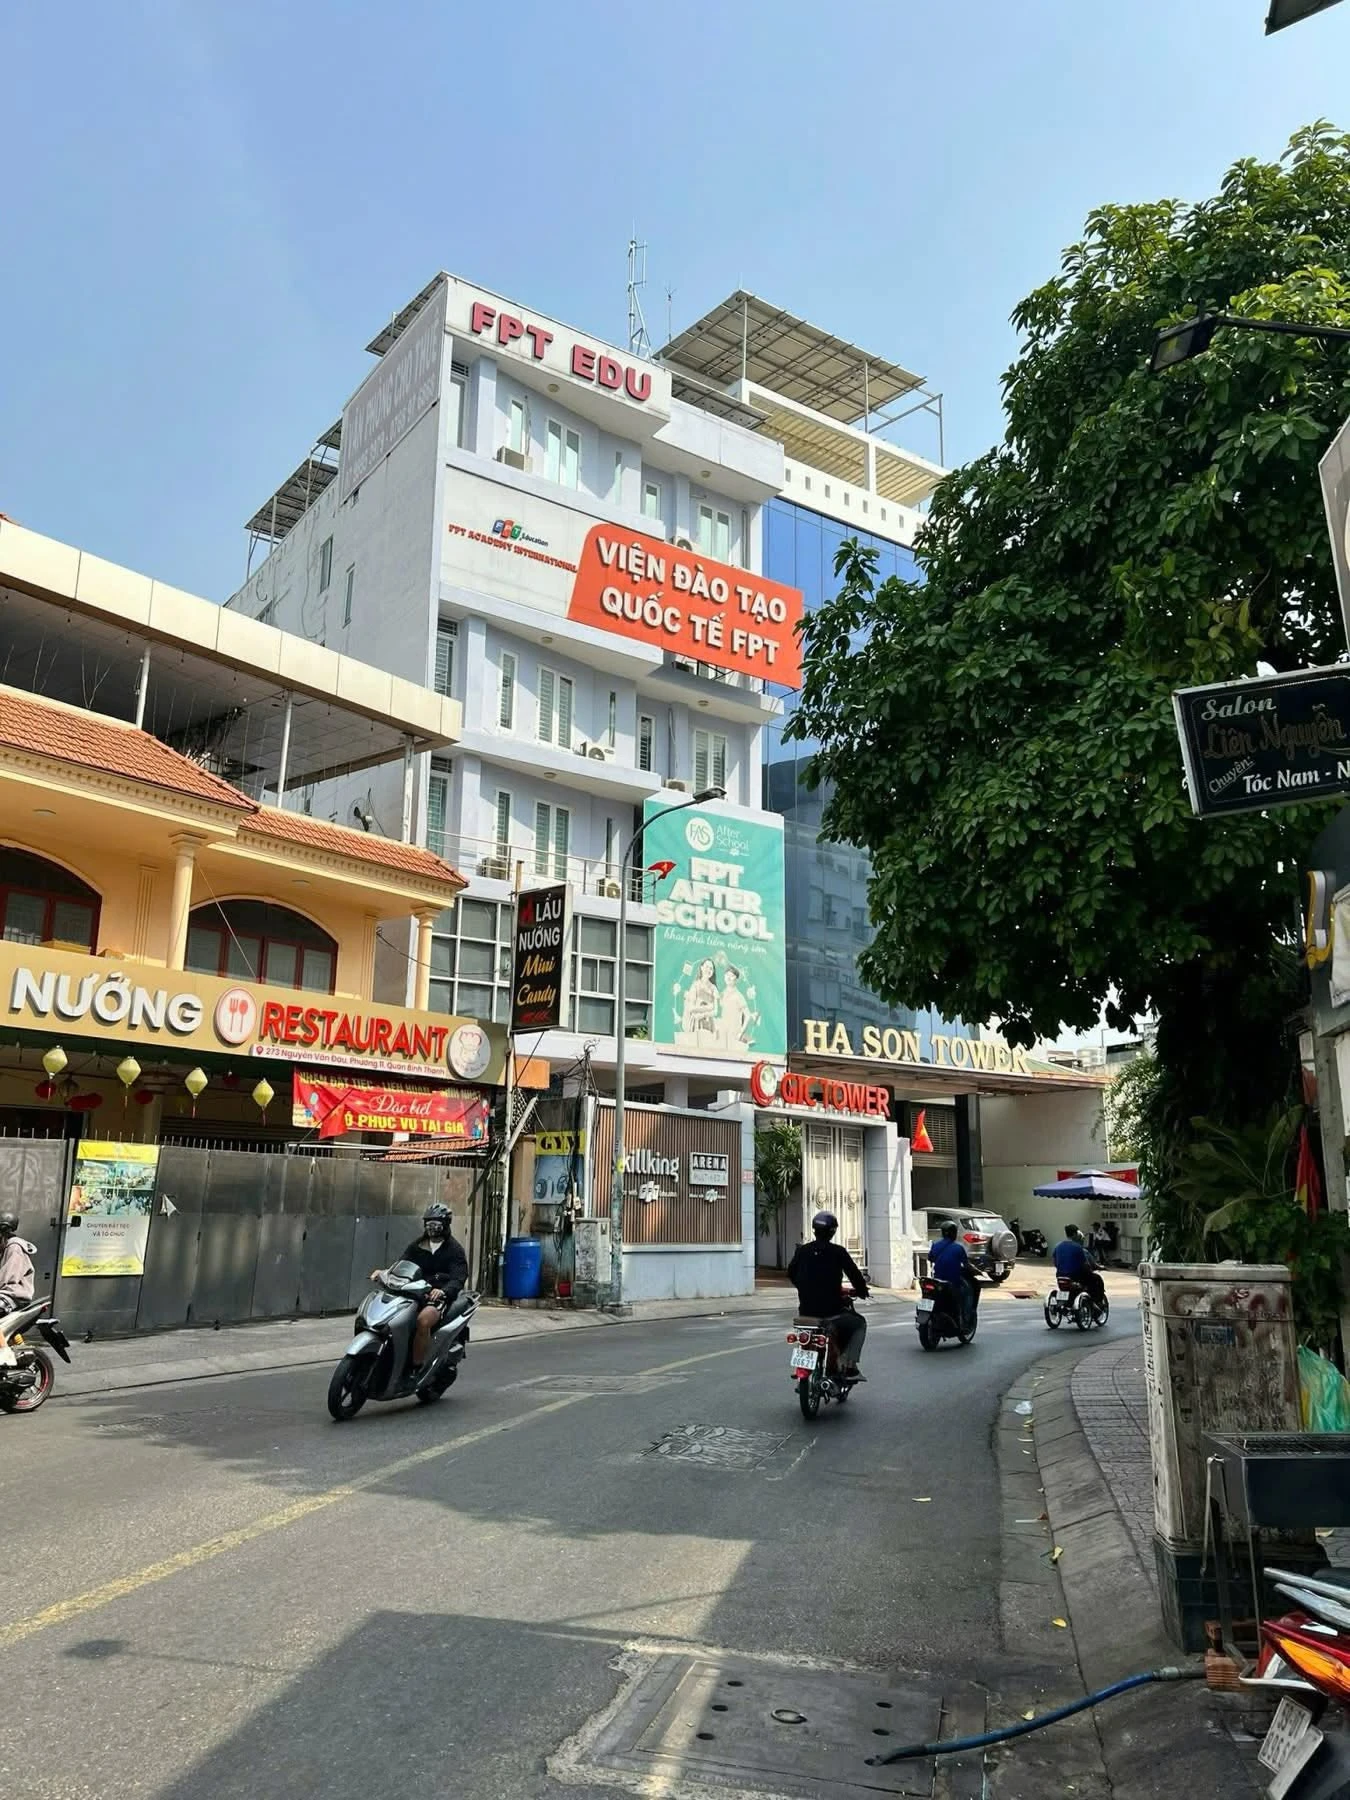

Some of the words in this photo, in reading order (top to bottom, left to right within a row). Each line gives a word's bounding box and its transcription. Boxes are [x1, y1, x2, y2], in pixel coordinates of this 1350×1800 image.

[472, 302, 554, 360] FPT
[572, 343, 651, 401] EDU
[448, 523, 466, 536] FPT
[468, 530, 513, 552] ACADEMY
[514, 545, 578, 573] INTERNATIONAL
[597, 536, 666, 583] VIỆN
[672, 563, 730, 604] ĐÀO
[735, 585, 787, 623] TẠO
[601, 587, 682, 634] QUỐC
[689, 612, 726, 648] TẾ
[731, 629, 780, 664] FPT
[1201, 696, 1277, 720] Salon
[1203, 723, 1257, 759] Liên
[1260, 703, 1347, 761] Nguyễn
[1209, 756, 1254, 793] Chuyên:
[1243, 774, 1272, 794] Tóc
[1277, 769, 1320, 789] Nam
[1337, 760, 1350, 779] N
[717, 824, 740, 841] After
[717, 836, 749, 851] School
[689, 857, 744, 888] FPT
[535, 893, 562, 922] LẨU
[669, 878, 762, 916] AFTER
[656, 900, 774, 941] SCHOOL
[519, 926, 561, 952] NƯỚNG
[520, 954, 556, 978] Mini
[11, 967, 204, 1032] NƯỚNG
[517, 983, 557, 1008] Candy
[261, 1001, 449, 1062] RESTAURANT
[804, 1019, 854, 1055] HA
[863, 1025, 921, 1063] SON
[932, 1035, 1033, 1077] TOWER
[266, 1048, 280, 1056] 273
[781, 1072, 817, 1107] GIC
[822, 1079, 891, 1117] TOWER
[400, 1118, 417, 1132] VỤ
[421, 1119, 440, 1134] TẠI
[623, 1148, 680, 1183] killking
[693, 1155, 726, 1170] ARENA
